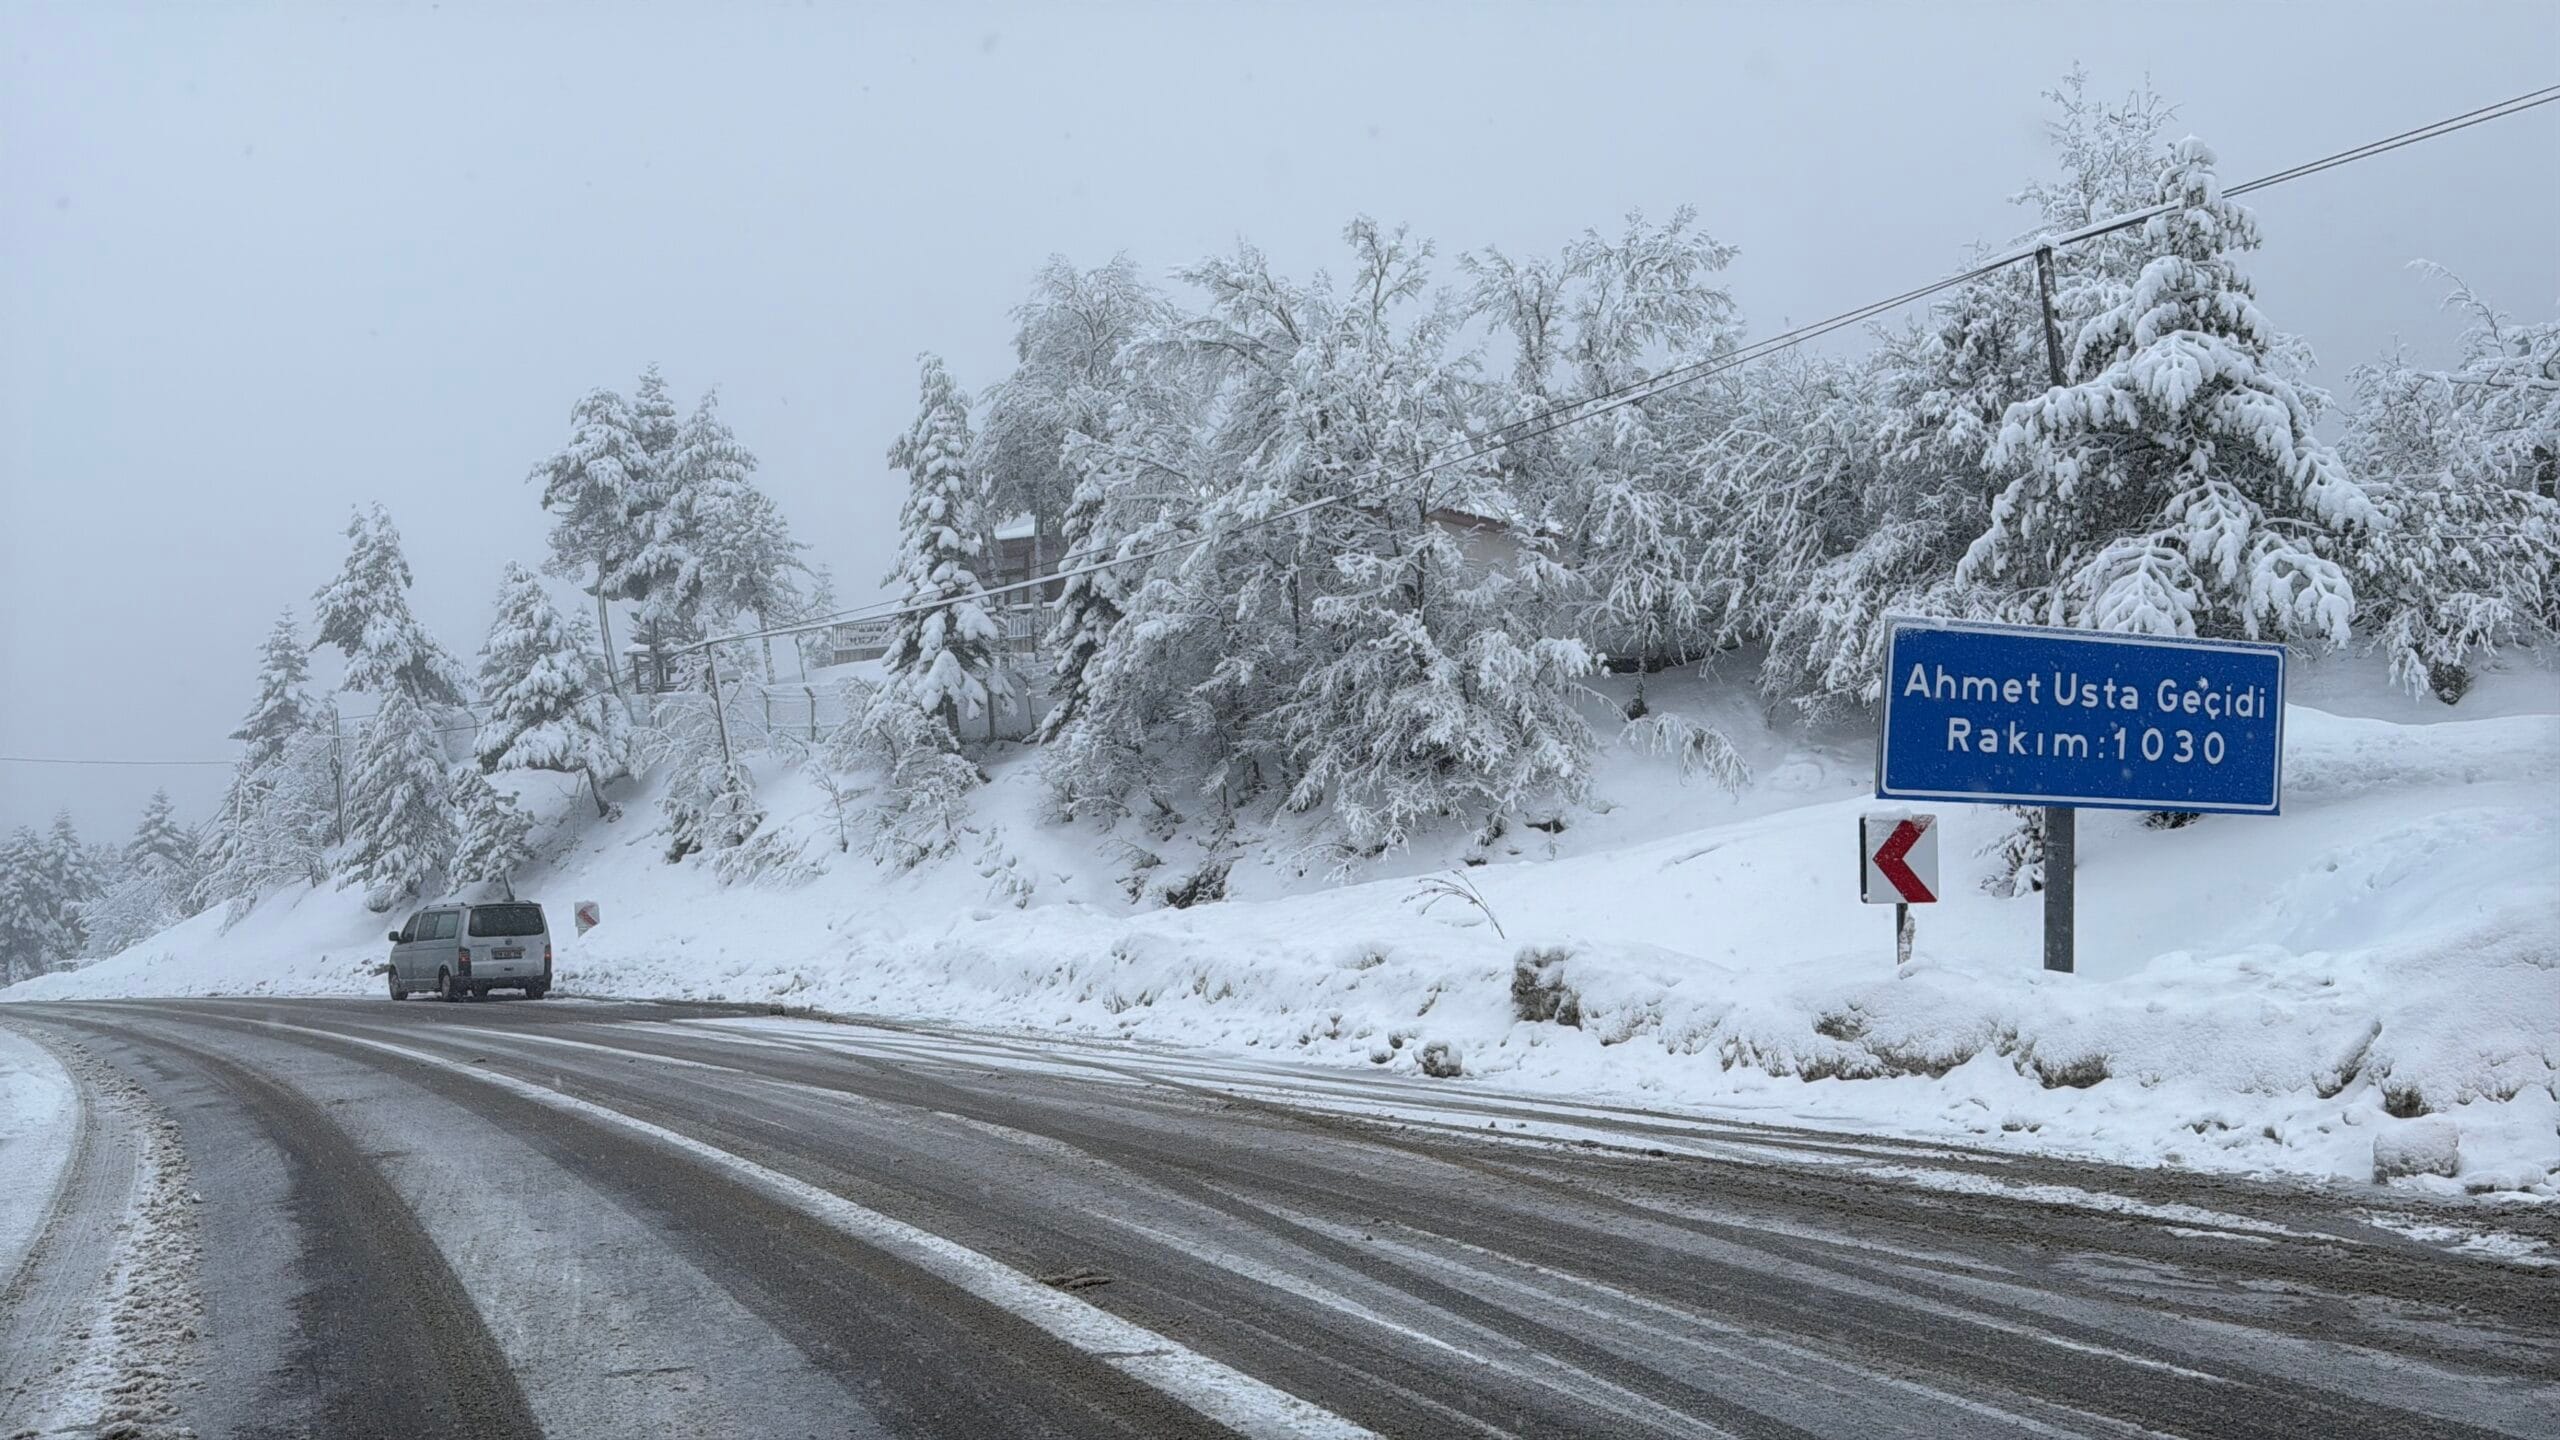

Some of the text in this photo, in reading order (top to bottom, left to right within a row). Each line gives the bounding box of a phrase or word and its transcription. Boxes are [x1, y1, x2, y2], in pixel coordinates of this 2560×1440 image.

[1904, 663, 2266, 720] Ahmet Usta Geçidi
